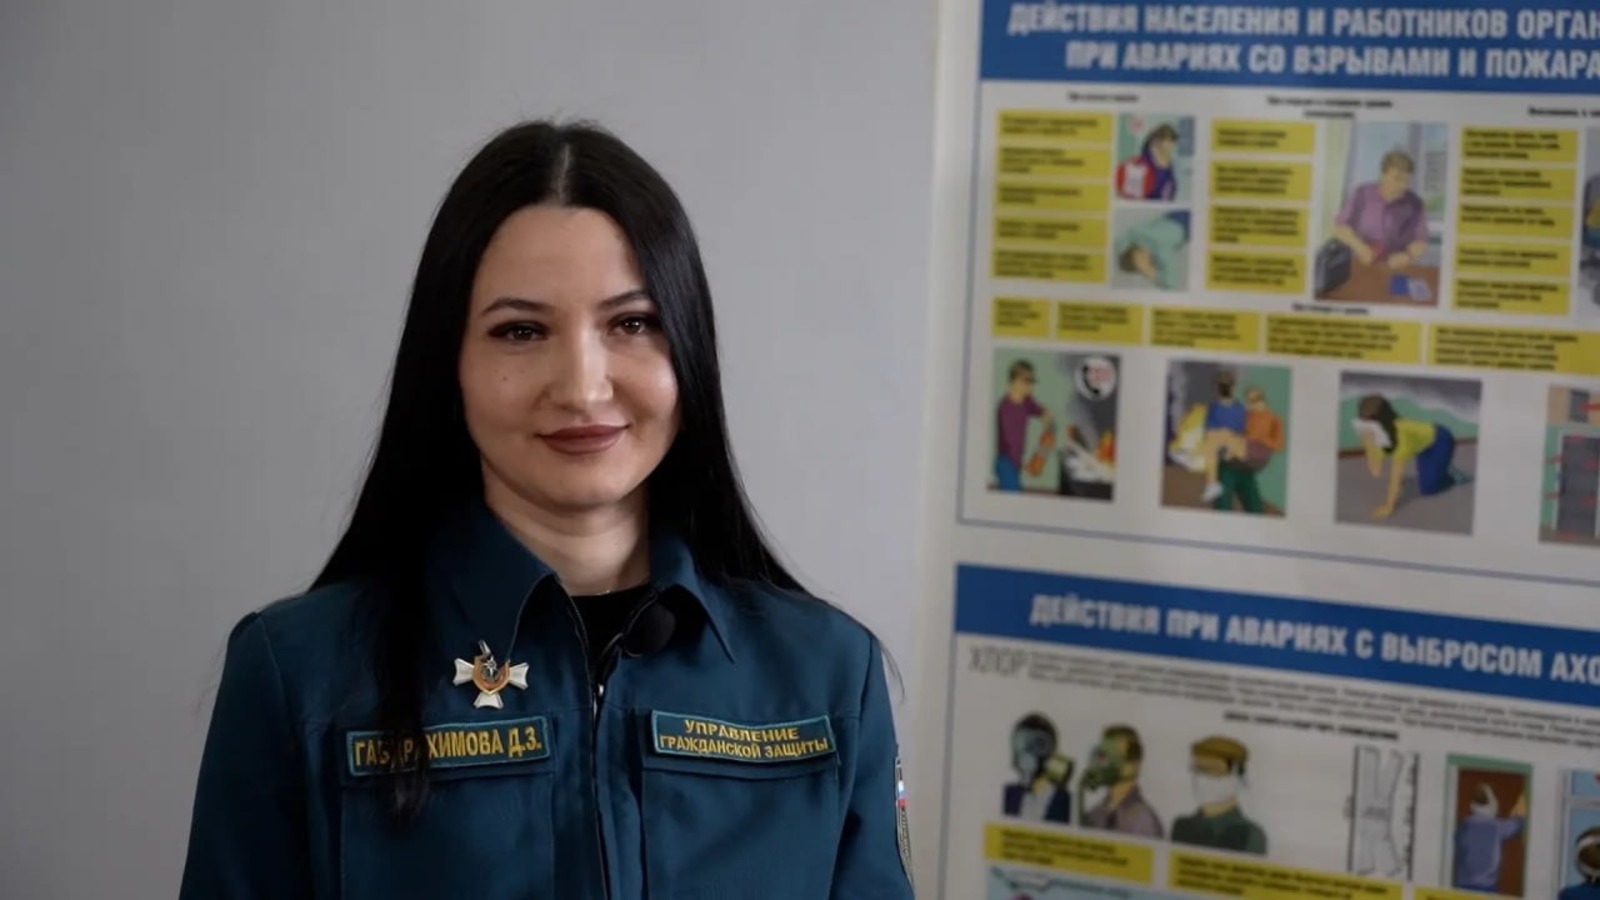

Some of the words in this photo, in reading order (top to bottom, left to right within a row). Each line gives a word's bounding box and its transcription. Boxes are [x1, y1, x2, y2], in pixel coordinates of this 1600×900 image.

[1008, 0, 1139, 35] ДЕЙСТВИЯ
[1145, 5, 1299, 35] НАСЕЛЕНИЯ
[1308, 7, 1324, 35] И
[1333, 8, 1508, 38] РАБОТНИКОВ
[1065, 41, 1117, 69] ПРИ
[1122, 43, 1240, 71] АВАРИЯХ
[1249, 44, 1285, 72] СО
[1293, 46, 1449, 76] ВЗРЫВАМИ
[1459, 48, 1476, 76] И
[1486, 48, 1600, 79] ПОЖАРА
[1029, 592, 1160, 634] ДЕЙСТВИЯ
[1167, 609, 1218, 641] ПРИ
[1226, 615, 1347, 654] АВАРИЯХ
[1355, 628, 1373, 658] С
[1382, 632, 1542, 678] ВЫБРОСОМ
[1550, 651, 1600, 686] АХО
[507, 726, 542, 758] Д.З.
[659, 735, 761, 759] ГРАЖДАНСКОЙ
[765, 738, 828, 759] ЗАЩИТЫ
[684, 719, 800, 742] УПРАВЛЕНИЕ
